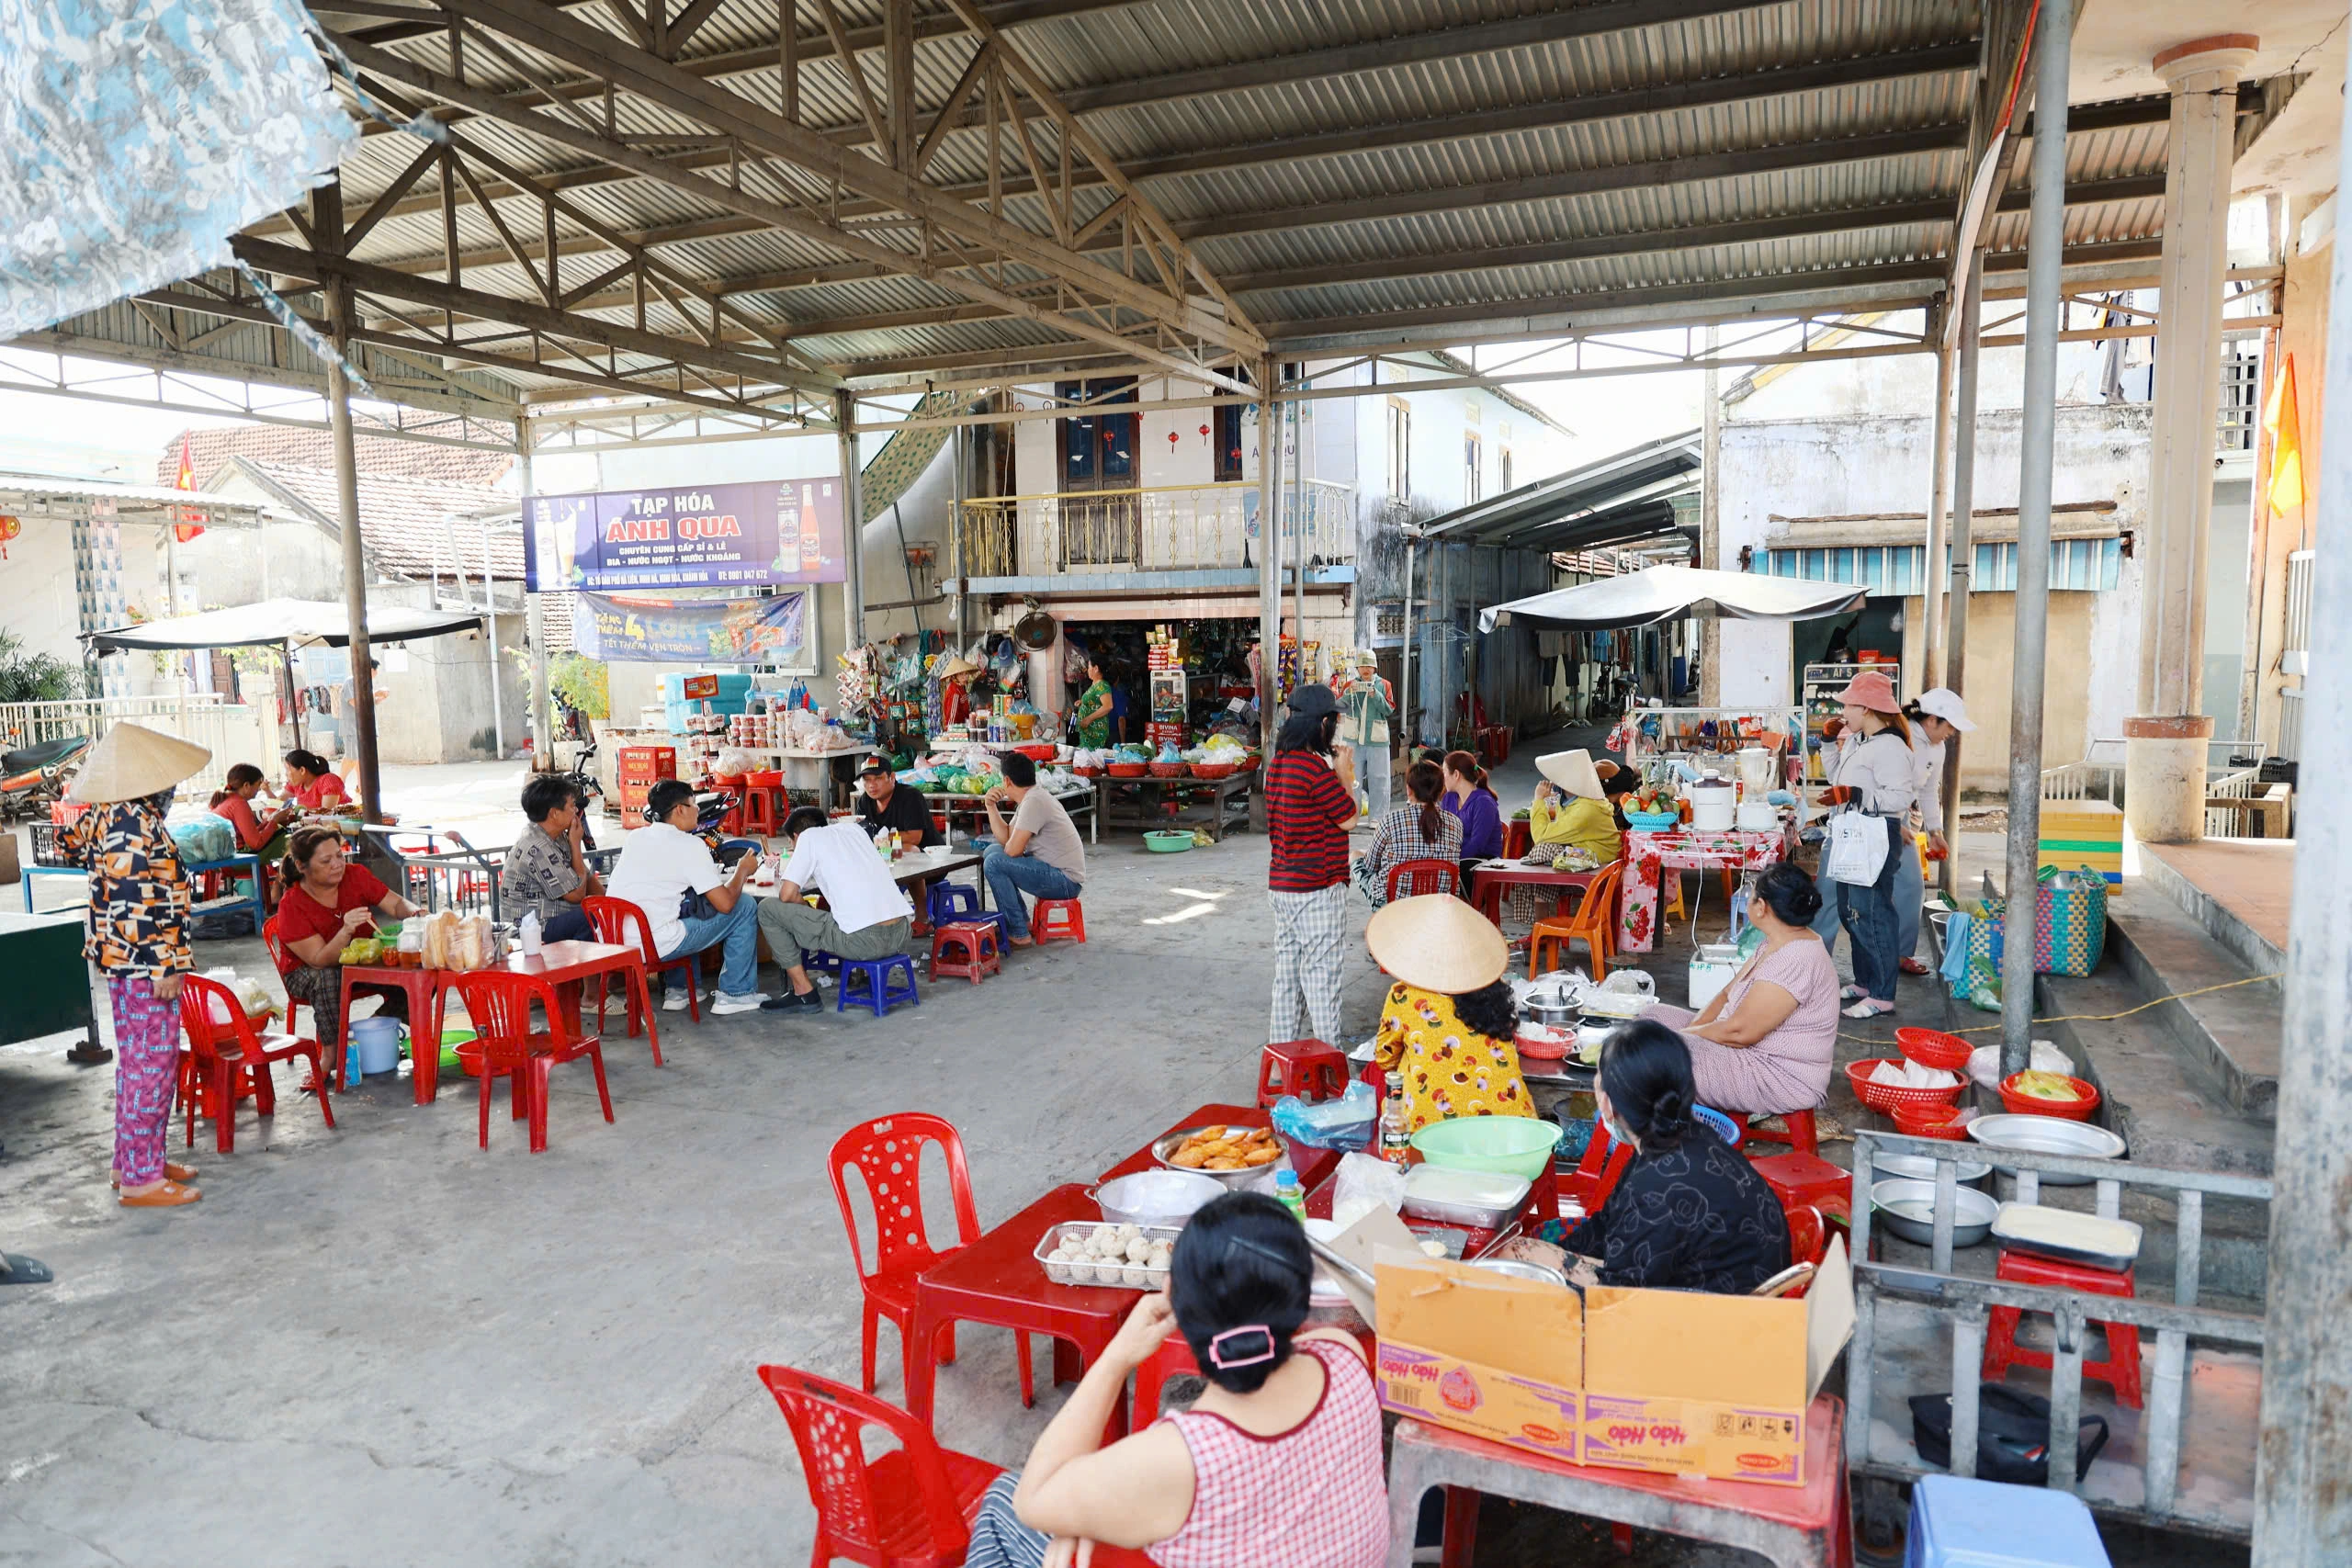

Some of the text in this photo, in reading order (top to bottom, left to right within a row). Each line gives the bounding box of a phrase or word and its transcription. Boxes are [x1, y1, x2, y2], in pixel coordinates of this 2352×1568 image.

[631, 491, 715, 518] TẠP HÓA
[605, 514, 742, 543] ÁNH QUA
[618, 544, 651, 556] CHUYÊN
[653, 544, 675, 554] CUNG
[677, 542, 695, 552] CẤP
[707, 543, 714, 551] &
[606, 558, 620, 567] BIA
[628, 555, 650, 566] NƯỚC
[651, 555, 673, 567] NGỌT
[681, 553, 704, 564] NƯỚC
[706, 551, 741, 562] KHOÁNG
[594, 610, 622, 626] TẶNG
[624, 613, 646, 641] 4
[594, 623, 625, 636] THÊM
[604, 637, 693, 654] TẾT THÊM VẸN TRÒN
[1382, 1359, 1440, 1382] Hảo Hảo
[1608, 1426, 1689, 1448] Hảo Hảo
